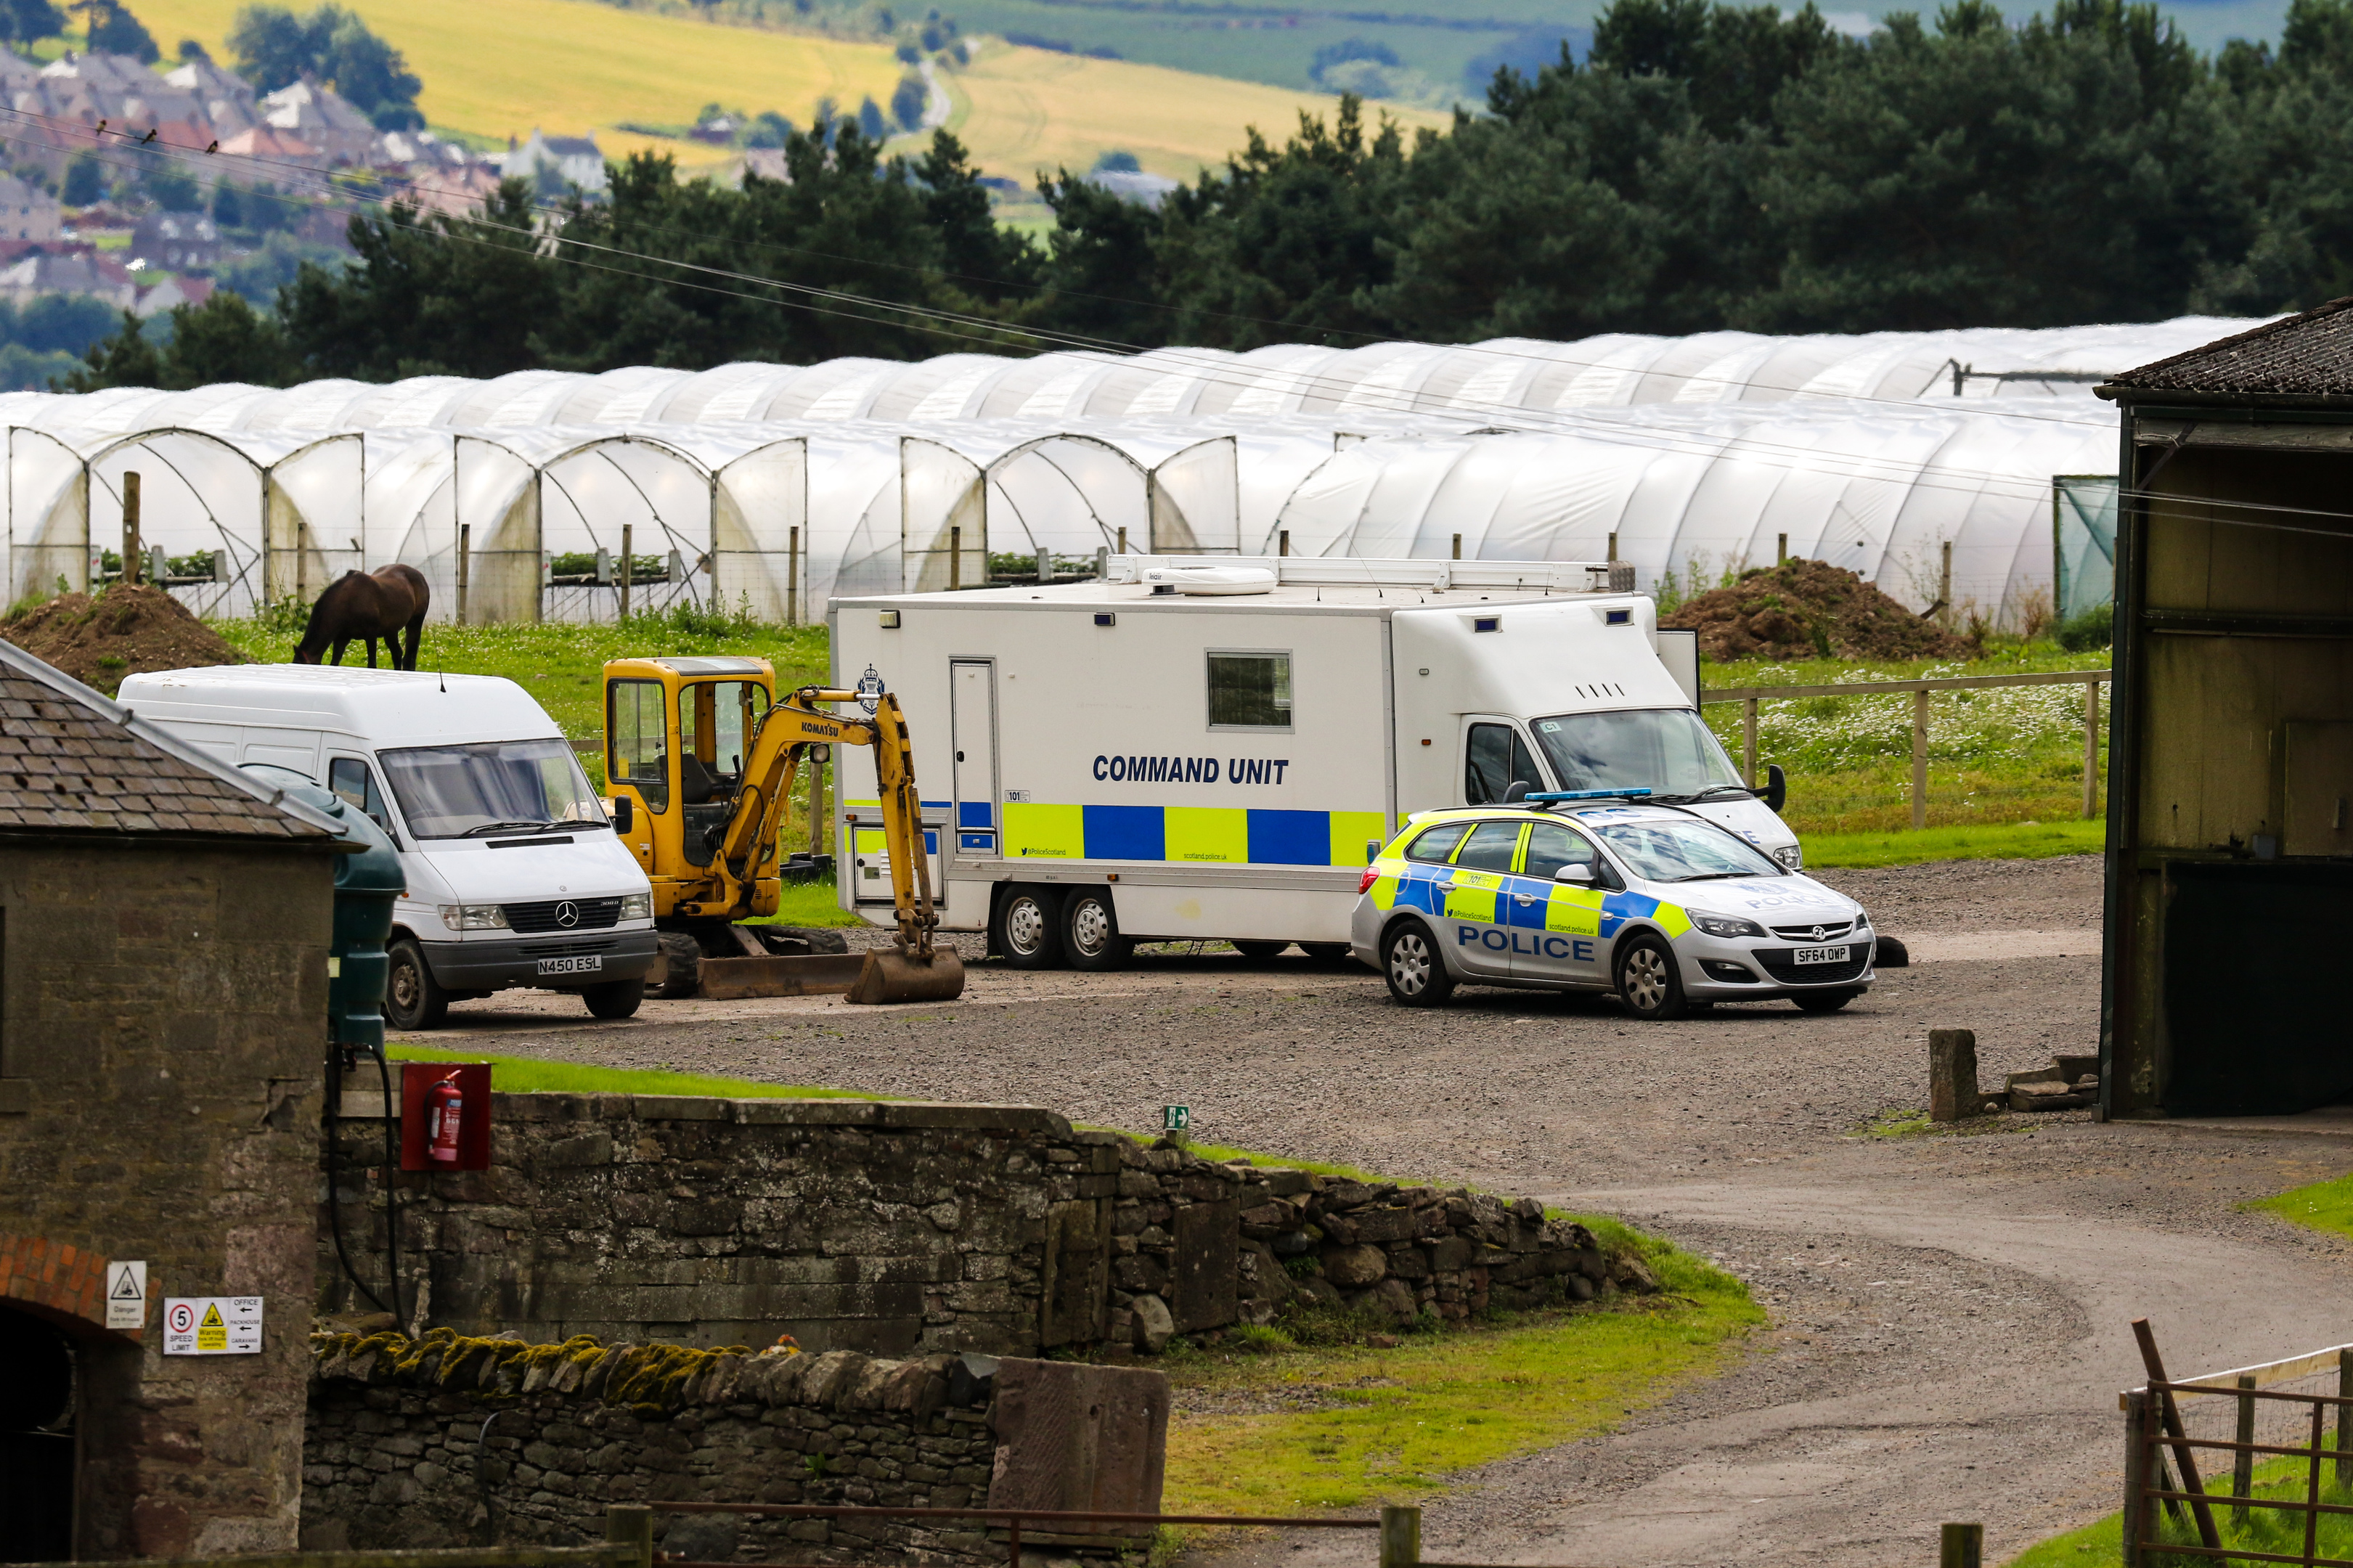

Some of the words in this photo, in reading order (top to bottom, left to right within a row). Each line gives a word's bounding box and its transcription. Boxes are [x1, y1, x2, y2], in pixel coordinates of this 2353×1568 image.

[802, 722, 839, 737] KOMATSU
[1093, 755, 1220, 783] COMMAND
[1228, 759, 1289, 785] UNIT
[1009, 791, 1020, 801] 101
[1183, 852, 1228, 861] scotland.police.uk
[1469, 875, 1481, 884] 101
[1745, 894, 1834, 909] POLICE
[1453, 910, 1493, 922] @PoliceScotland
[1549, 923, 1595, 935] scotland.police.uk
[1458, 926, 1596, 962] POLICE
[1799, 950, 1826, 963] SF64
[1828, 947, 1846, 960] OWP
[539, 959, 573, 973] N450
[576, 957, 601, 971] ESL
[177, 1310, 187, 1326] 5
